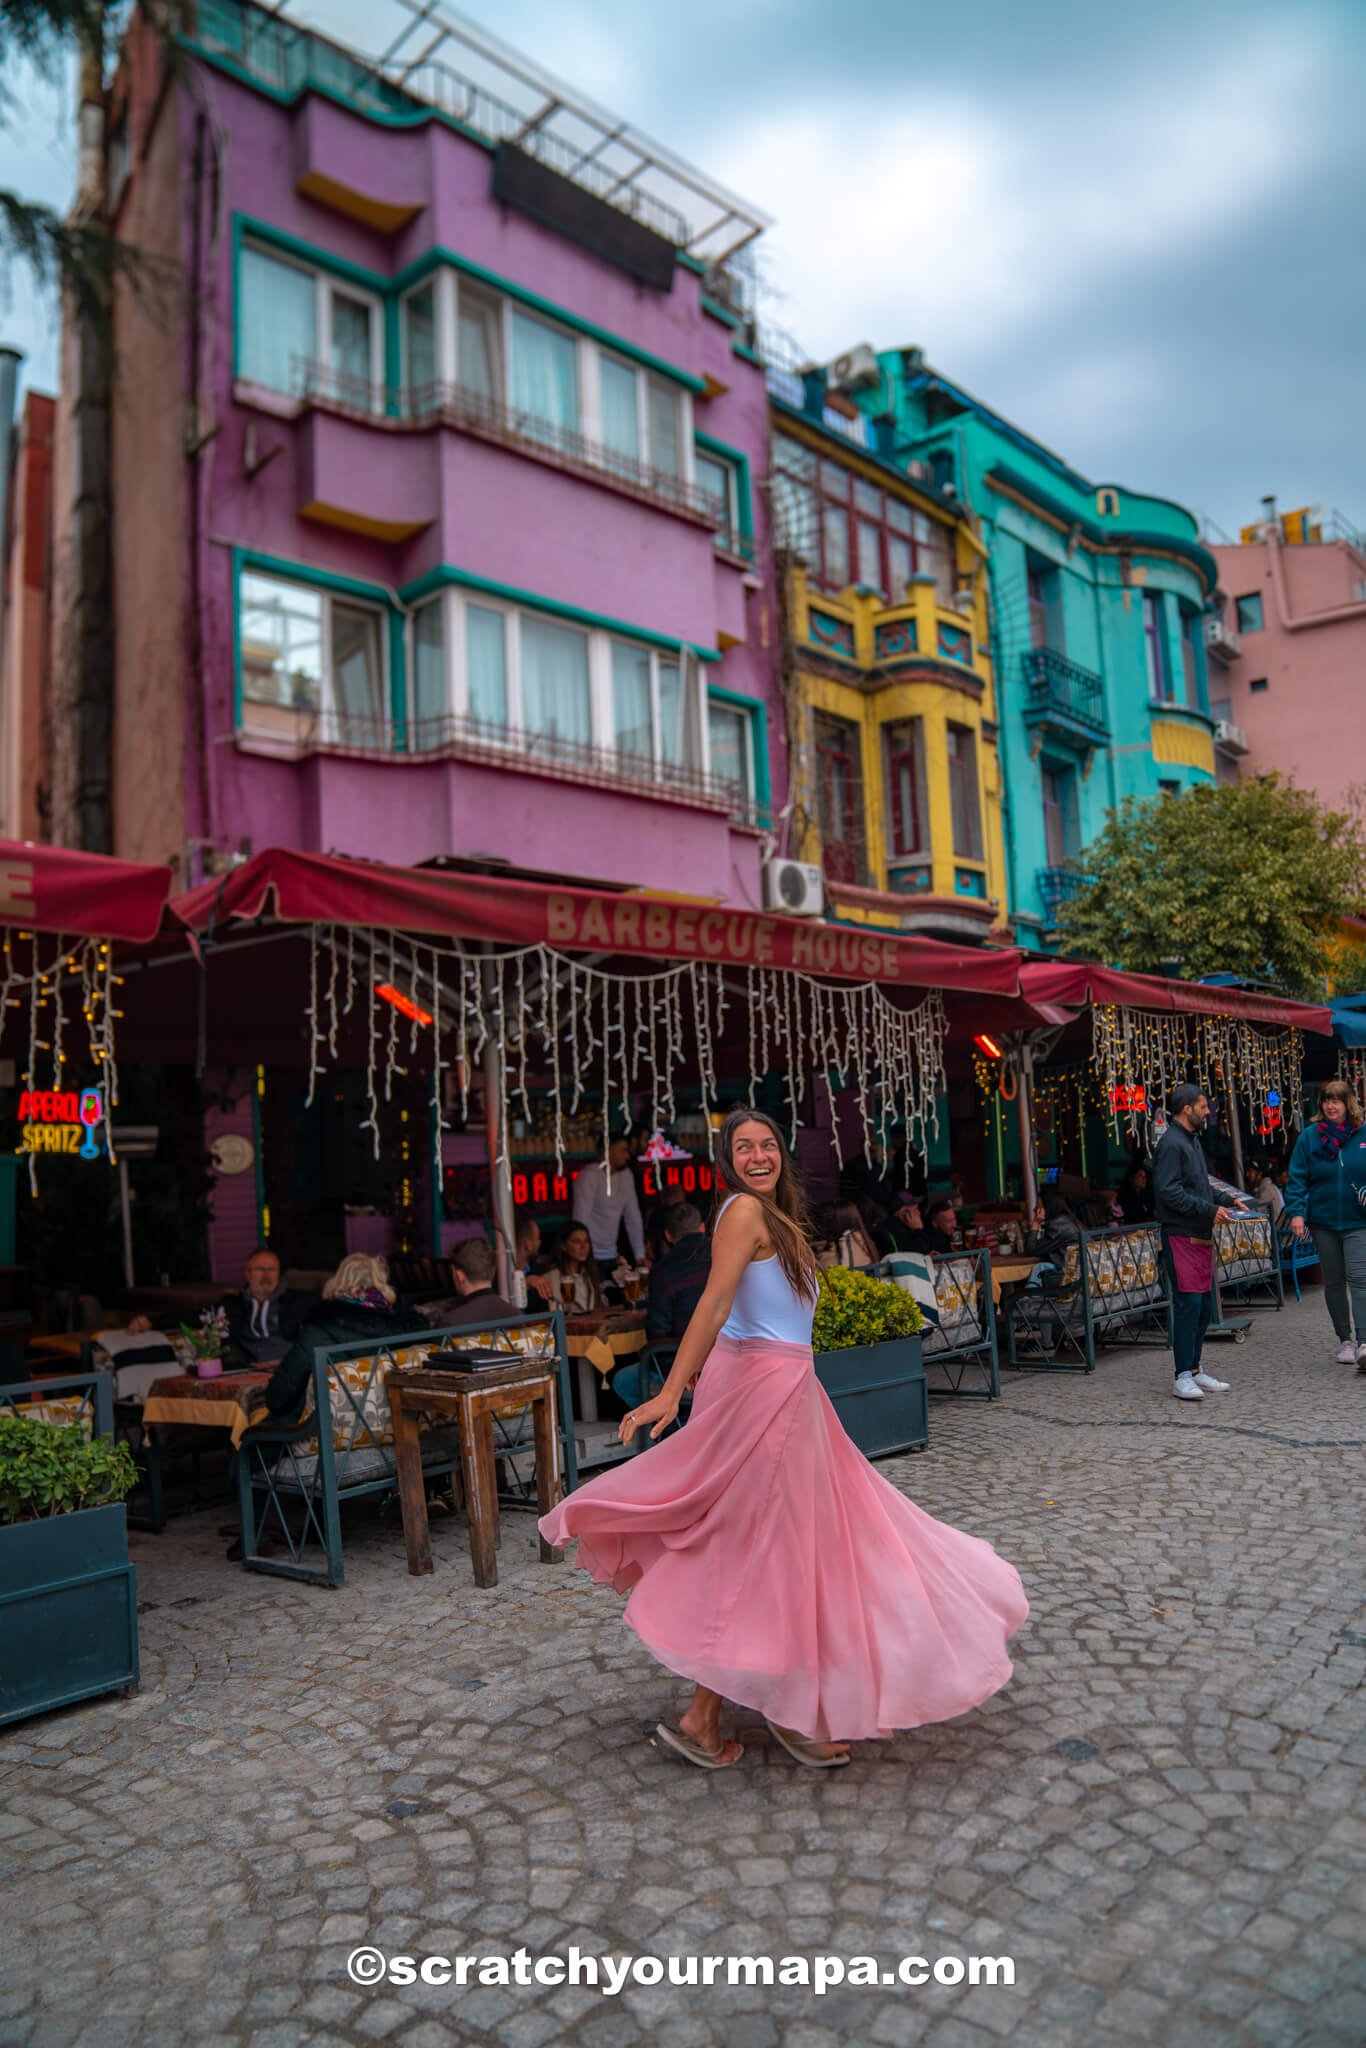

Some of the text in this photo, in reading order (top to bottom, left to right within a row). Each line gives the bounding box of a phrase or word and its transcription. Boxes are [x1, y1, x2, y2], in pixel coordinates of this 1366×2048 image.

[547, 895, 899, 977] BARBECUE HOUSE
[18, 1091, 81, 1122] APEROL
[22, 1124, 82, 1153] SPRITZ
